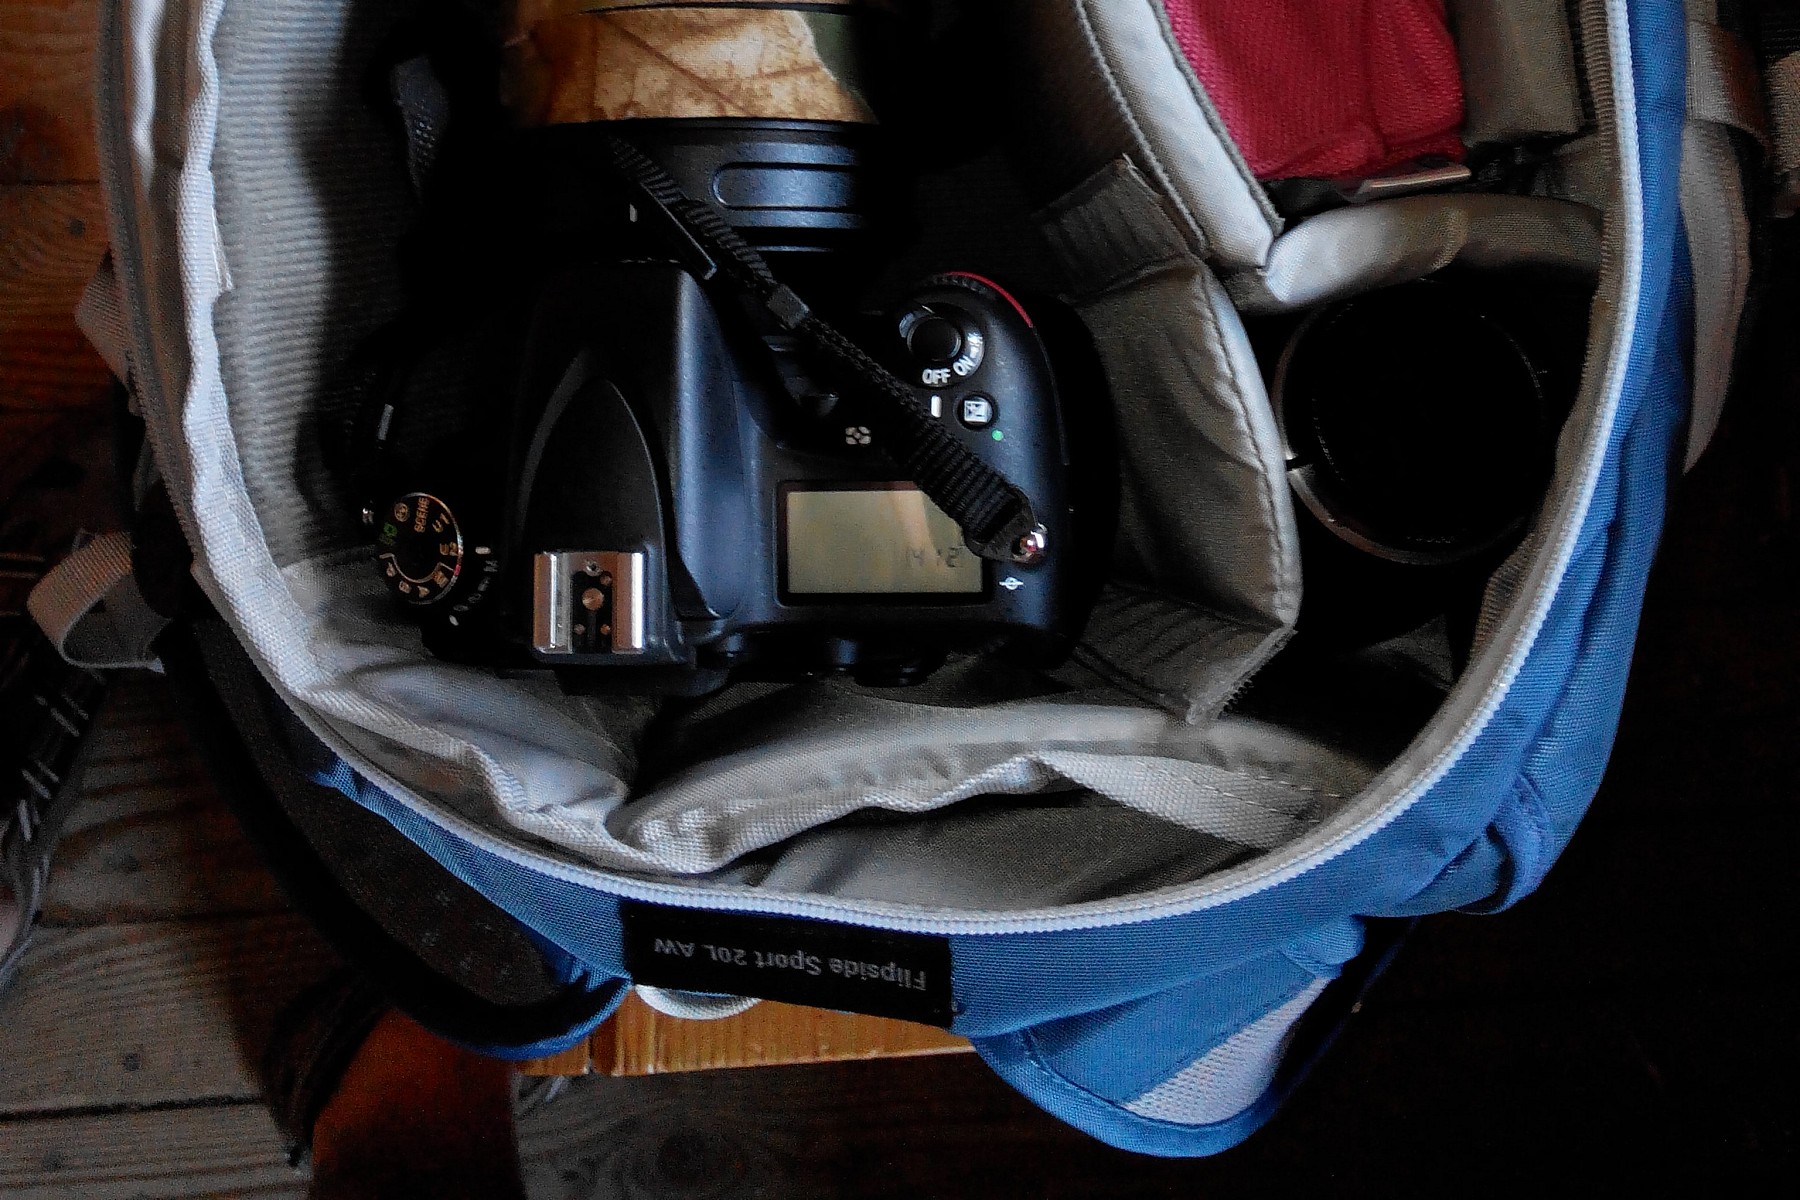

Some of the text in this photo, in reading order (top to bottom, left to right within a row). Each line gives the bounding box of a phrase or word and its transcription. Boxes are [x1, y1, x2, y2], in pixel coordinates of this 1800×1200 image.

[922, 355, 976, 384] OFF ON
[654, 937, 928, 992] Flipside Sport 20L AW
